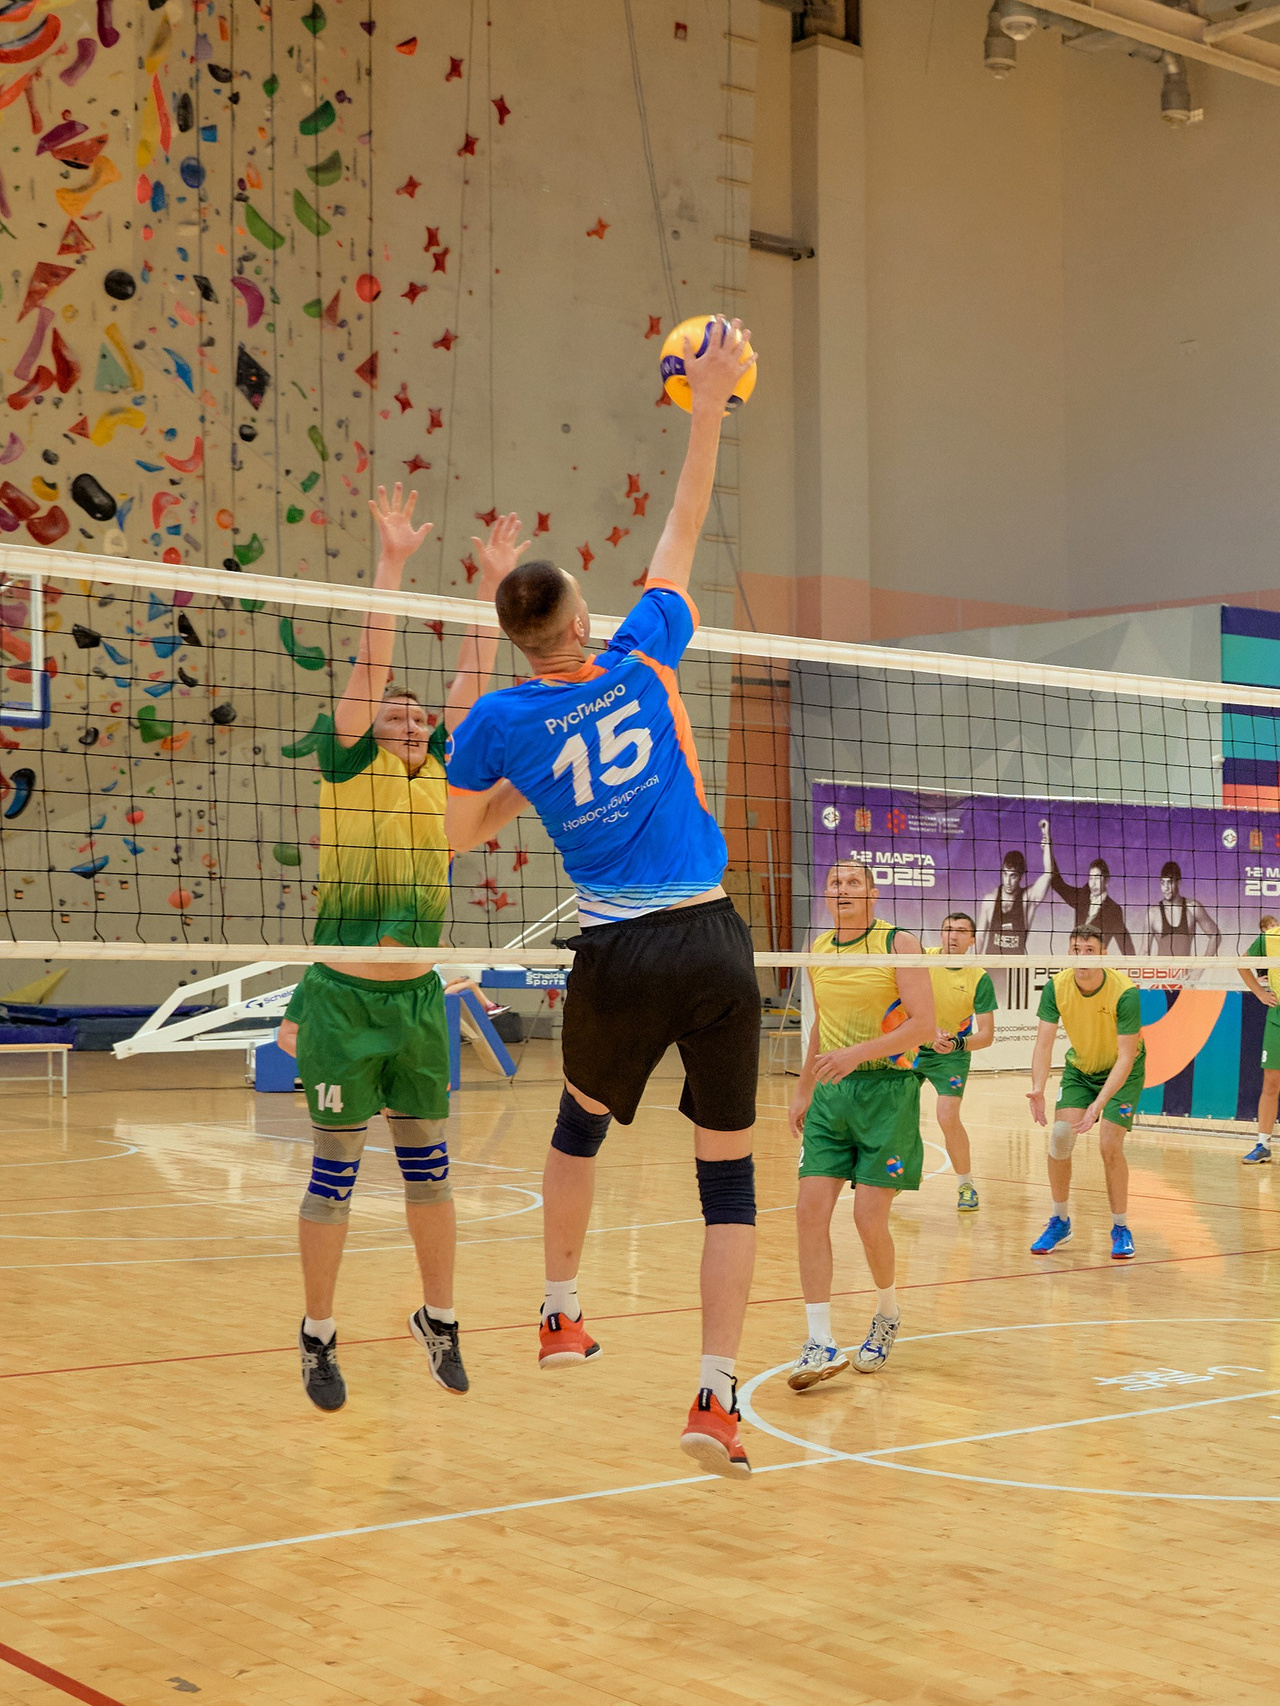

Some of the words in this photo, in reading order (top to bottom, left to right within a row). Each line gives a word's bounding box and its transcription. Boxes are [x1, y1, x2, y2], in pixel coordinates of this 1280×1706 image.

[545, 684, 626, 734] РусГидро
[552, 700, 653, 807] 15
[850, 850, 873, 863] 1-2
[876, 851, 935, 866] МАРТА
[868, 865, 936, 888] 025
[1245, 866, 1263, 878] 1-2
[315, 1083, 344, 1113] 14
